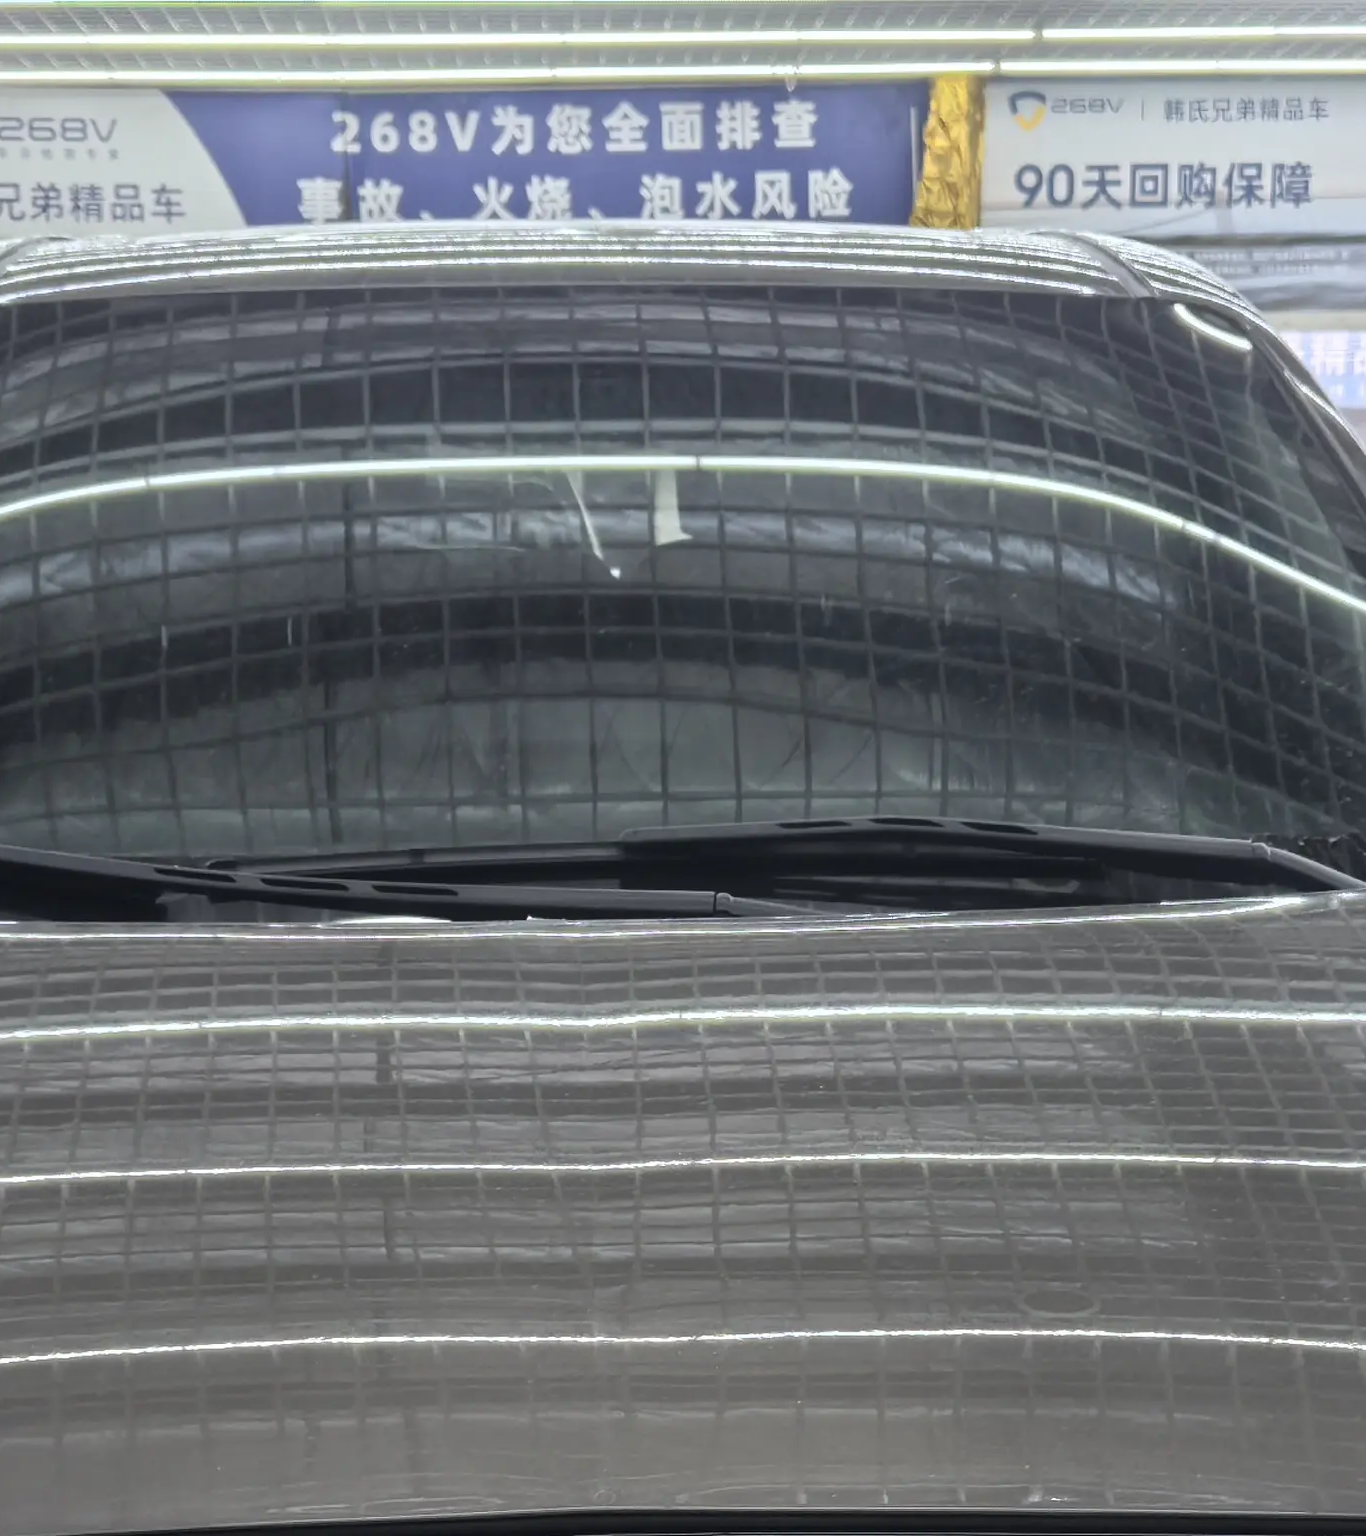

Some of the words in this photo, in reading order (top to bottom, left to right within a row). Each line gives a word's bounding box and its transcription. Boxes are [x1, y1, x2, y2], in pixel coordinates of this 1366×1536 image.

[331, 101, 817, 155] 268V为您全面排查
[1051, 99, 1124, 114] 268V
[1163, 97, 1330, 123] 韩氏兄弟精品车
[1014, 161, 1313, 209] 90天回购保障
